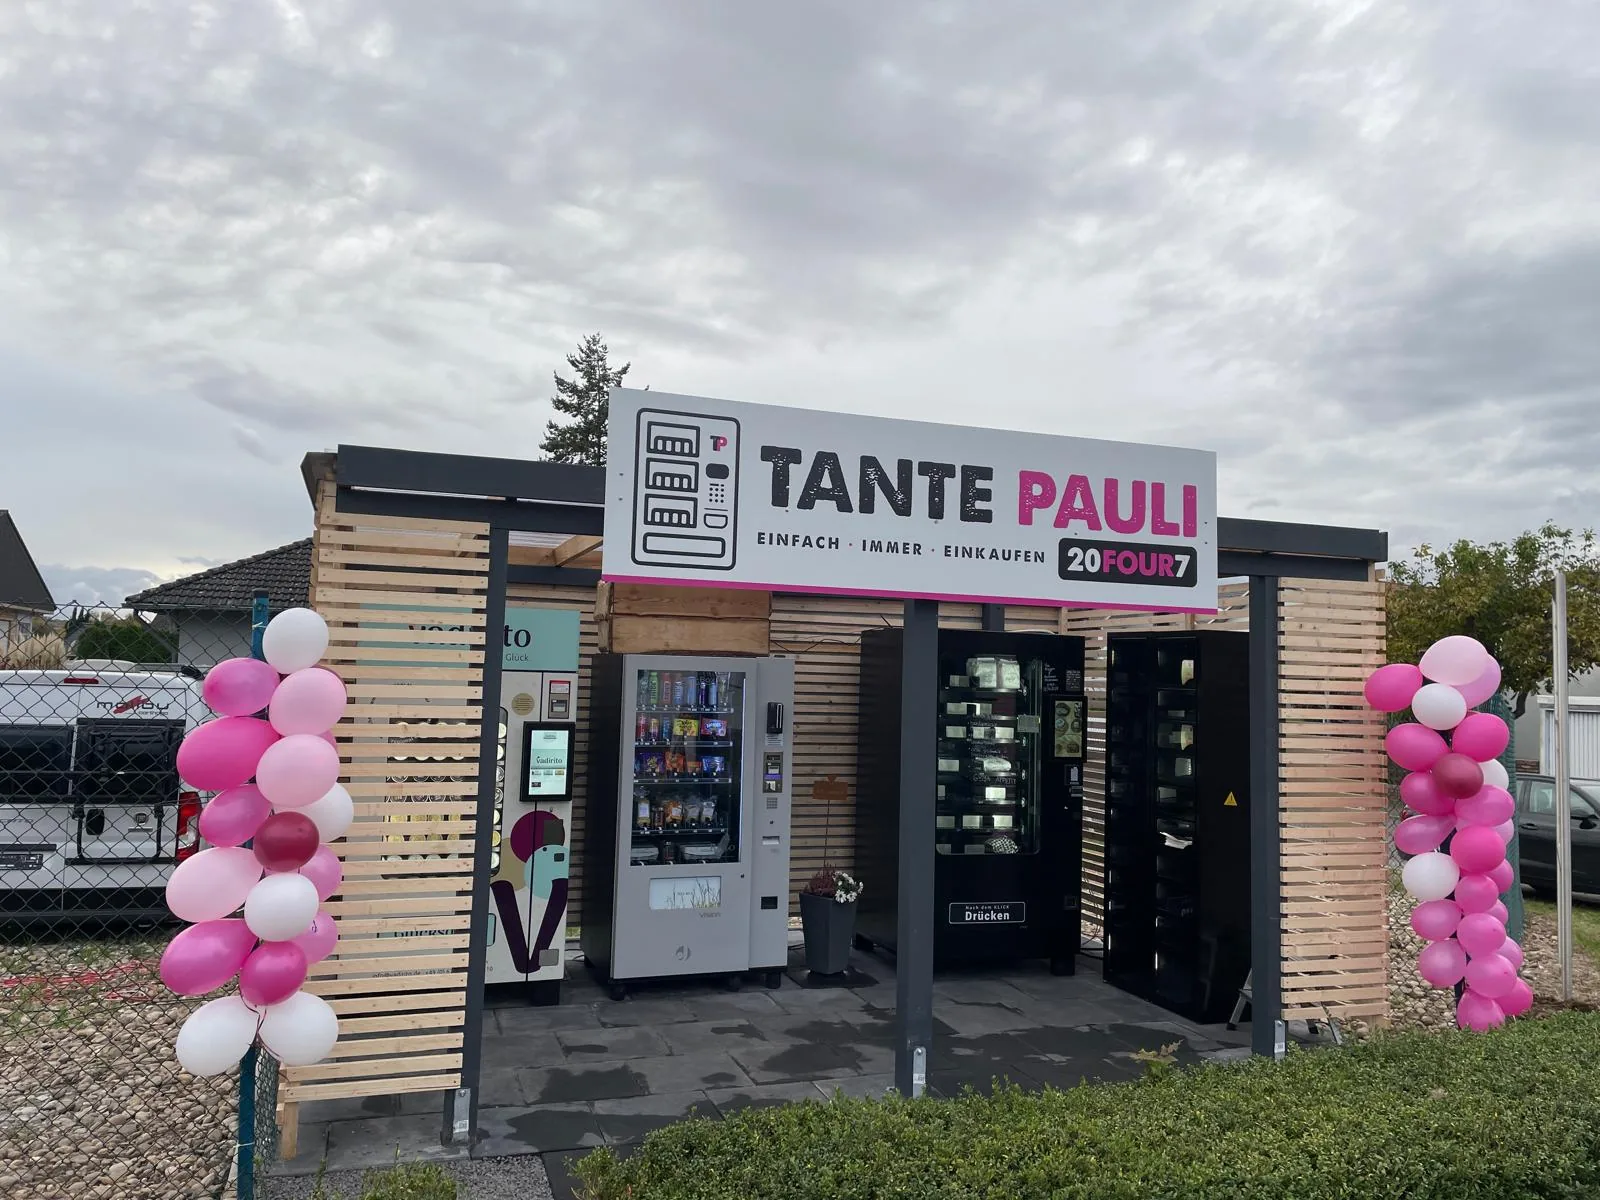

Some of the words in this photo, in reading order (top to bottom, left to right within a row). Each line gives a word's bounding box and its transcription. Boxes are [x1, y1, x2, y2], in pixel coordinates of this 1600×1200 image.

[761, 446, 993, 521] TANTE
[1019, 470, 1197, 538] PAULI
[757, 532, 840, 550] EINFACH
[862, 539, 922, 556] IMMER
[944, 545, 1046, 564] EINKAUFEN
[1067, 547, 1191, 578] 20FOUR7
[965, 910, 1010, 921] Drücken
